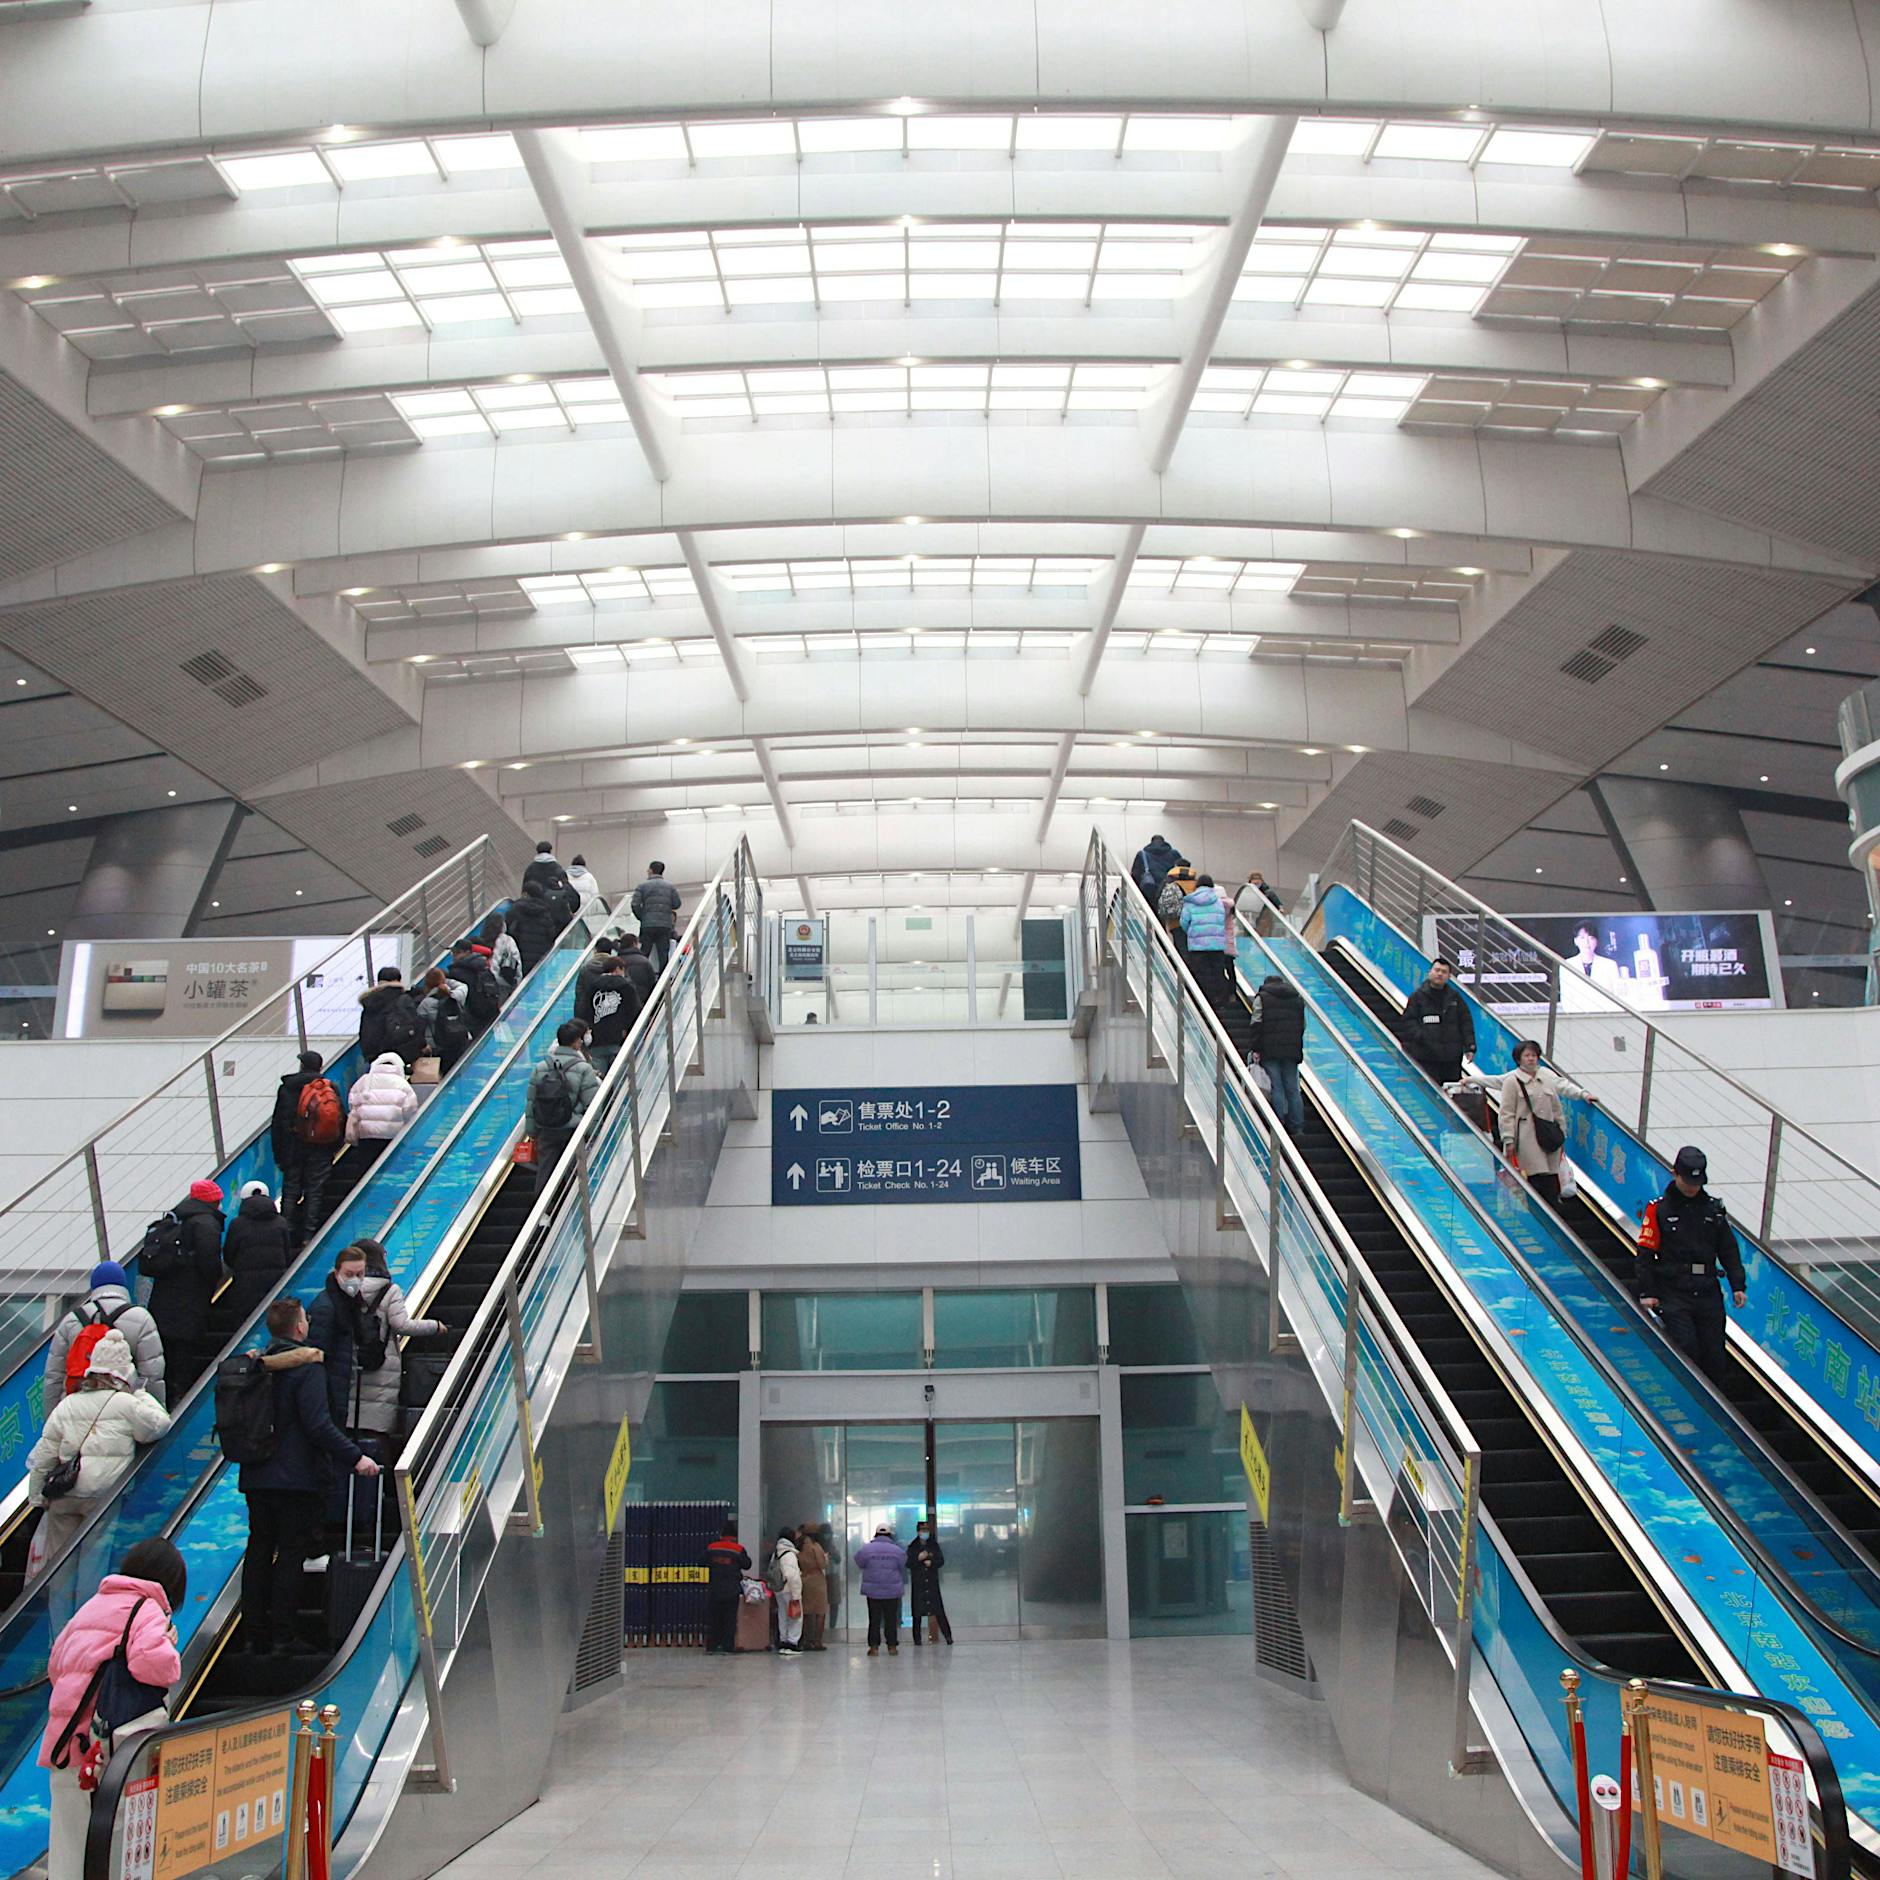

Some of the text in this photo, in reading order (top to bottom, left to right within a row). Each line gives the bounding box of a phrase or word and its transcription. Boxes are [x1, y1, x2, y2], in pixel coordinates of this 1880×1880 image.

[1691, 962, 1747, 976] 期待已久
[184, 980, 249, 999] 小罐茶
[858, 1100, 951, 1120] 售票处1-2
[858, 1122, 882, 1131] Ticket
[885, 1122, 909, 1131] Office
[929, 1121, 943, 1129] 1-2
[857, 1158, 963, 1179] 检票口1-24
[1010, 1157, 1062, 1175] 候车区
[857, 1180, 949, 1190] Ticket Check No. 1-24
[1010, 1176, 1061, 1187] Waiting Area
